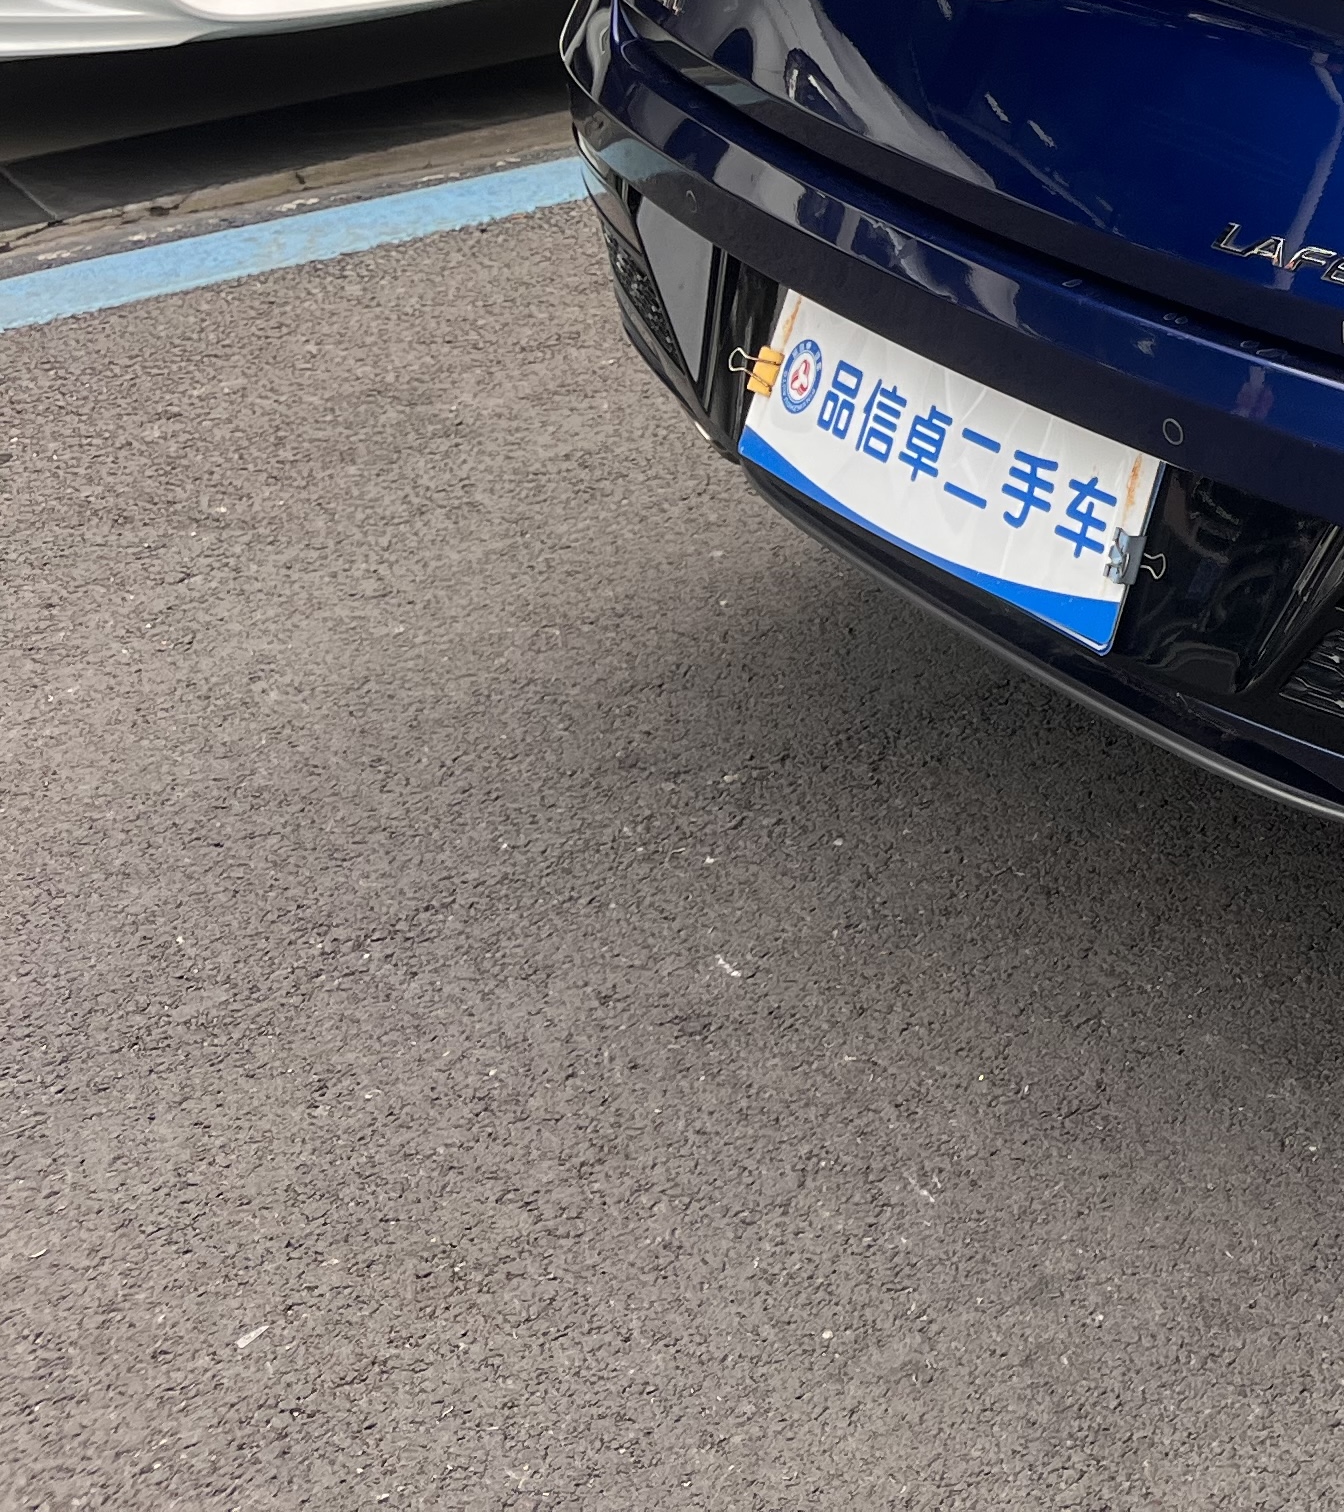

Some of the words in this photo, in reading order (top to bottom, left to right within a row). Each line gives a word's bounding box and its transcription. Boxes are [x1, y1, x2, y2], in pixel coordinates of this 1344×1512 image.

[816, 360, 1118, 559] 品信卓二手车
